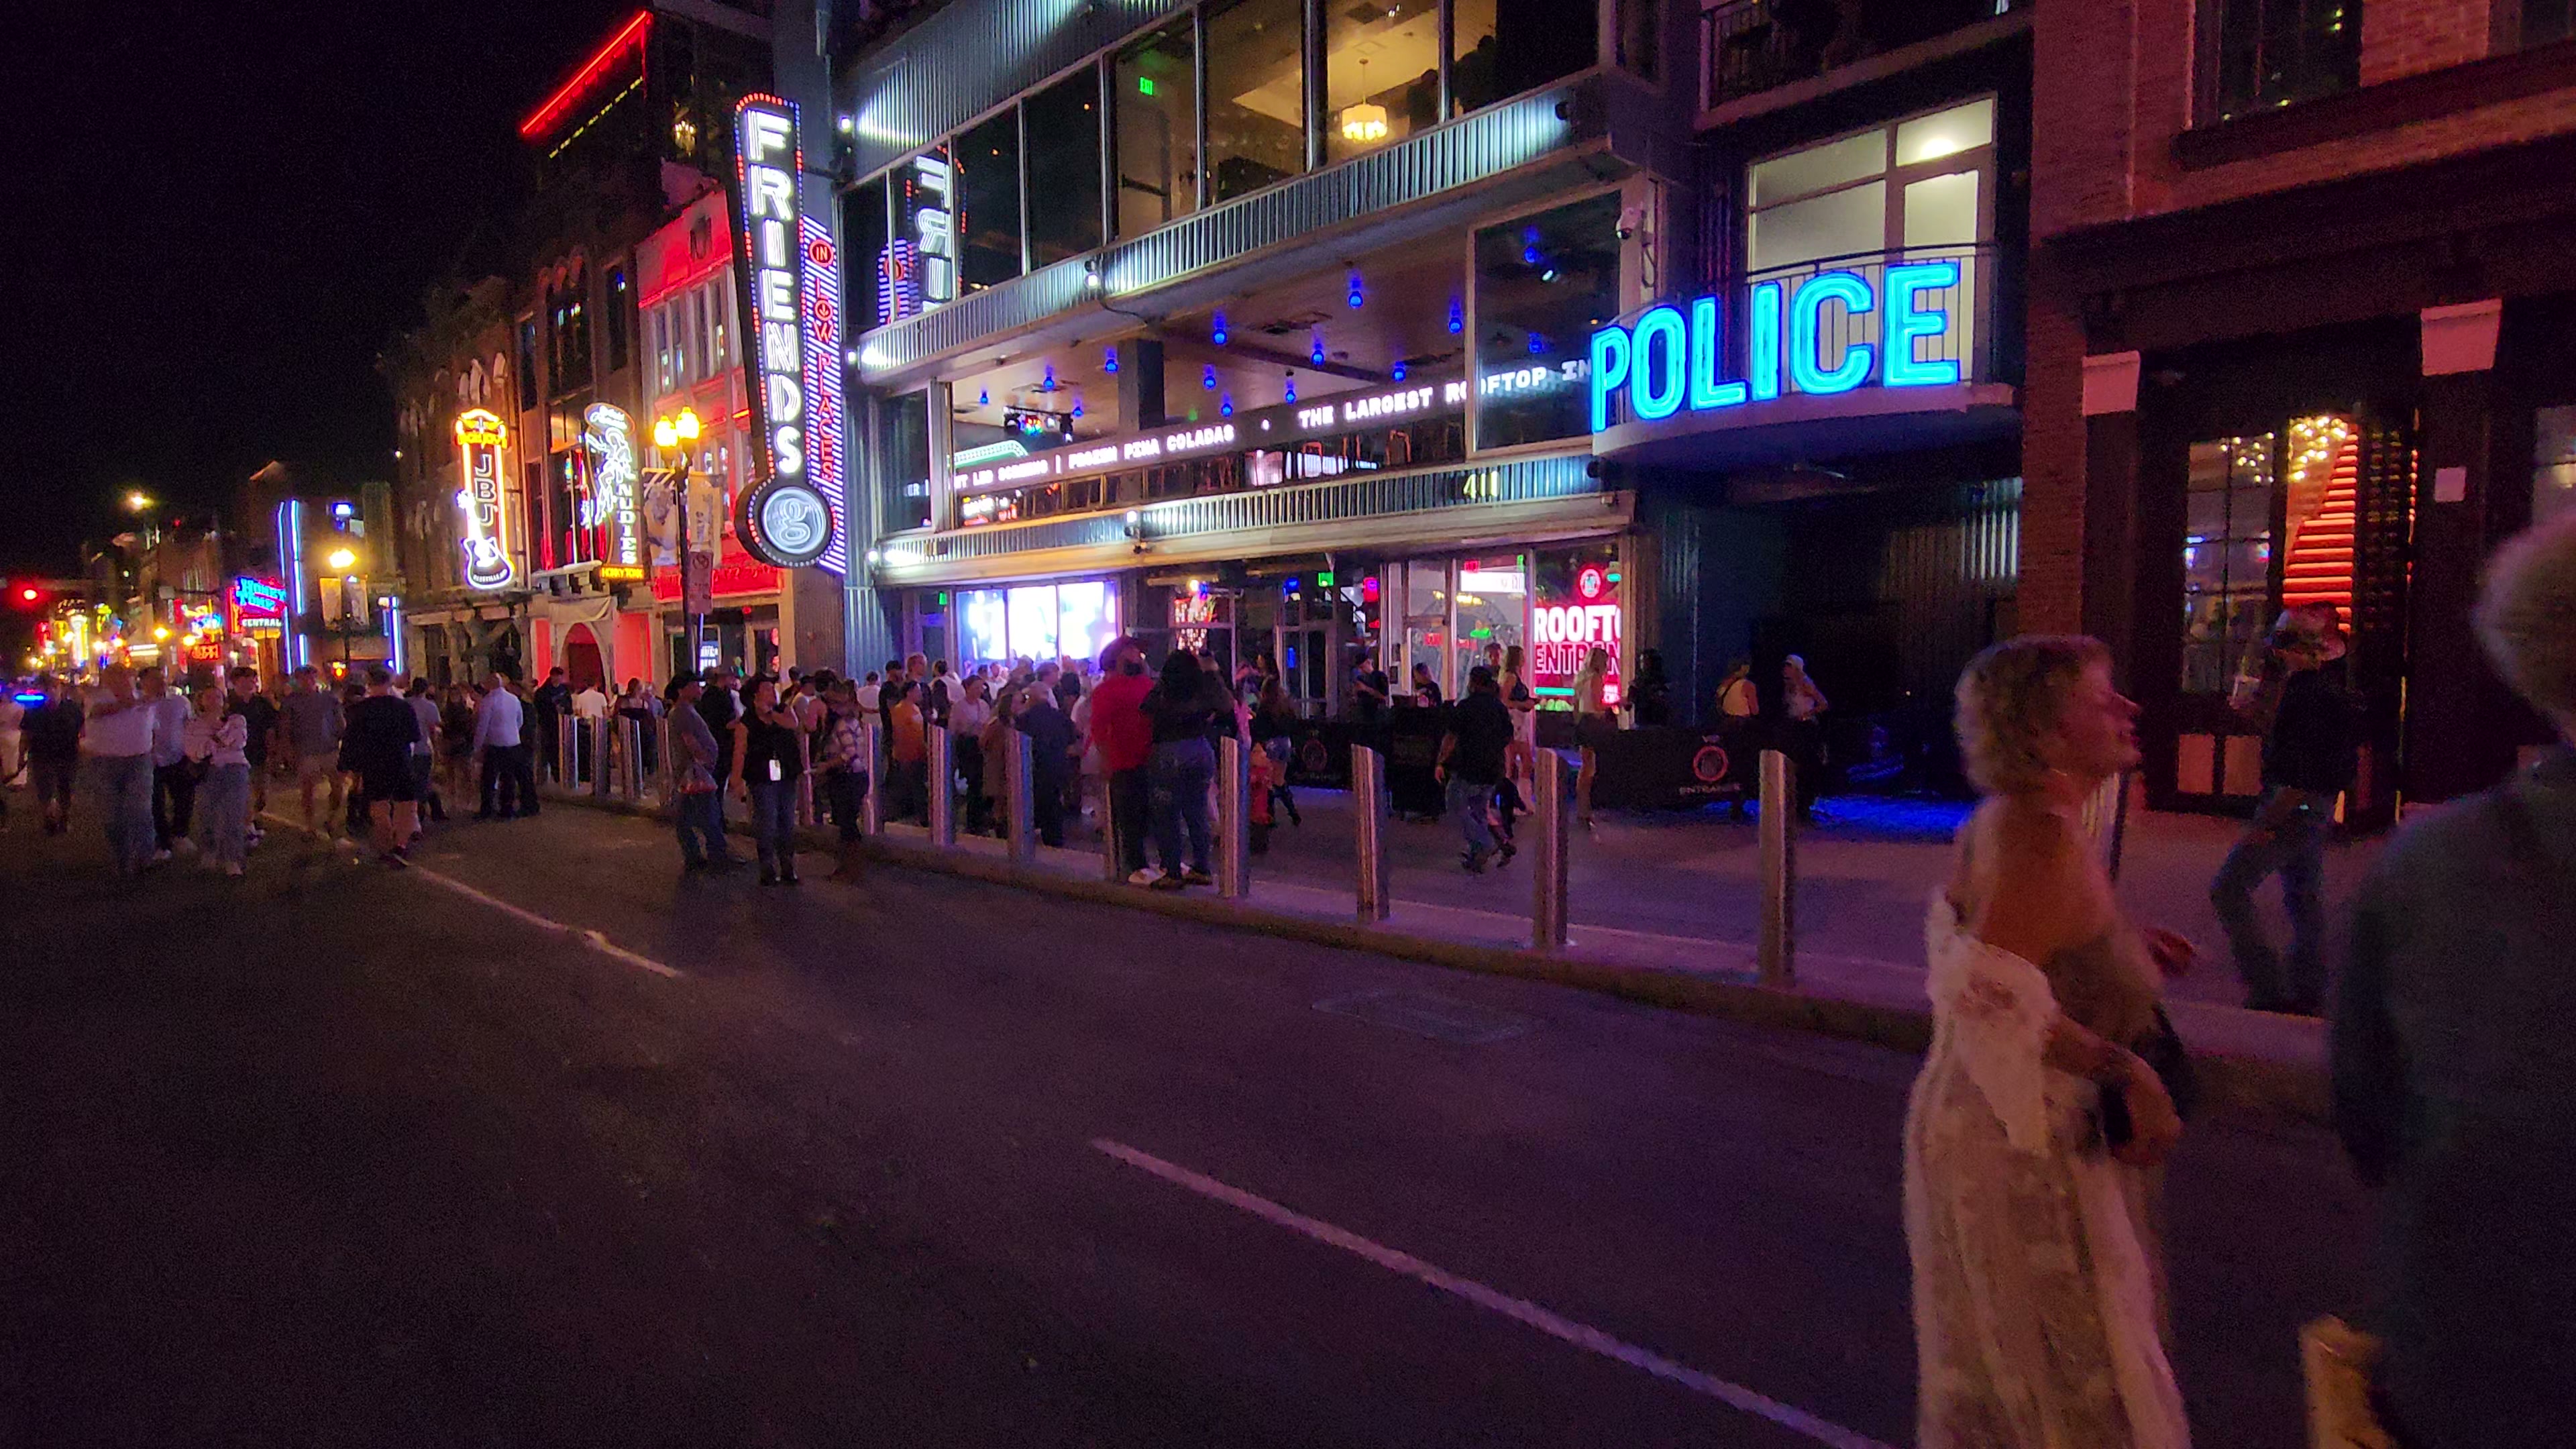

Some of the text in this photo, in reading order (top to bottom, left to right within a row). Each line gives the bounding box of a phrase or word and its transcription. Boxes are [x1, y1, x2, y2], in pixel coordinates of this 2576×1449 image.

[816, 246, 828, 262] IN
[745, 108, 802, 474] FRIENDS
[812, 277, 834, 343] LOW
[1591, 261, 1960, 433] POLICE
[816, 353, 835, 482] PLACES
[1298, 405, 1334, 429] THE
[1344, 386, 1434, 421] LARGEST
[1166, 424, 1235, 451] COLADAS
[1463, 470, 1500, 498] 411
[241, 619, 282, 627] CENTRAL
[1534, 641, 1621, 675] ENTRN
